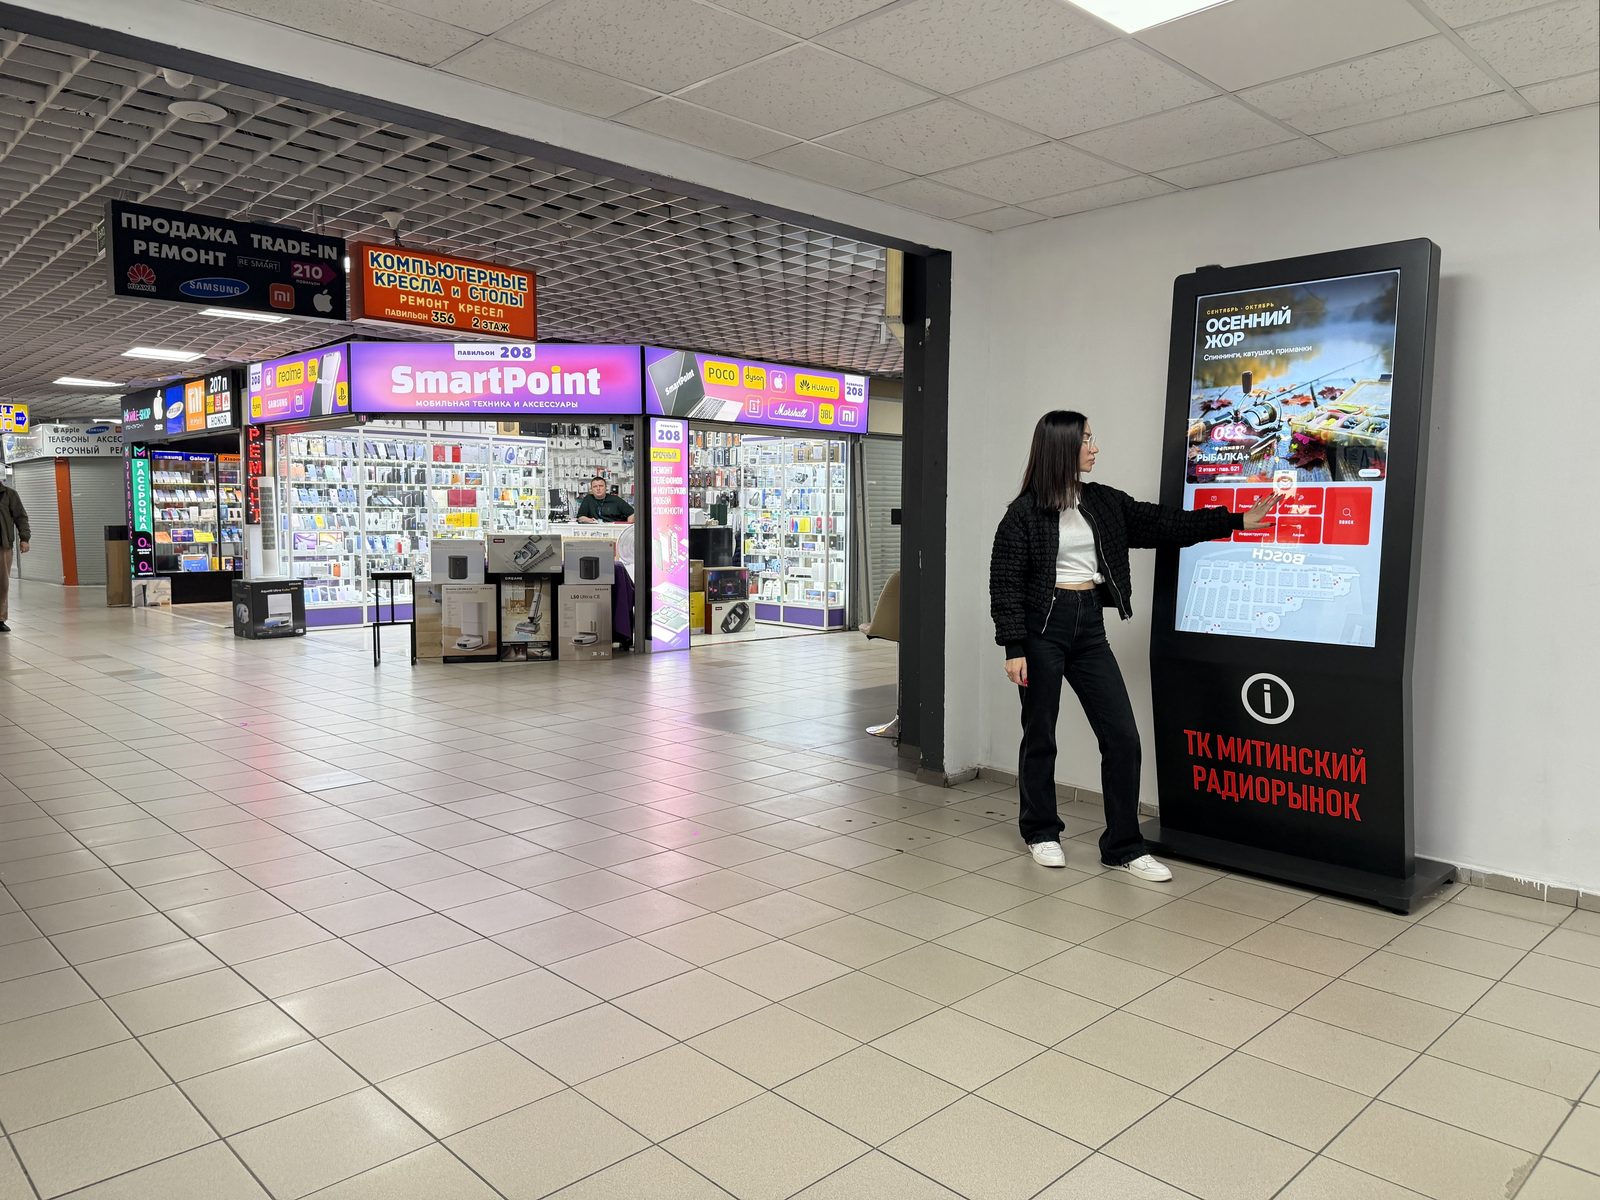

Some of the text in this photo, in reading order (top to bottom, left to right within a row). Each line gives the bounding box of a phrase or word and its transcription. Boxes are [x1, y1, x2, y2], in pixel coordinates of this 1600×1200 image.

[121, 212, 238, 245] ПРОДАЖА
[133, 239, 227, 267] РЕМОНТ
[250, 233, 338, 260] TRADE-IN
[293, 263, 323, 279] 210
[369, 250, 528, 292] КОМПЬЮТЕРНЫЕ
[189, 280, 240, 295] SAMSUNG
[374, 271, 444, 296] КРЕСЛА
[469, 286, 524, 308] СТОЛЫ
[400, 294, 503, 318] РЕМОНТ КРЕСЕЛ
[1206, 302, 1275, 315] СЕНТЯБРЬ ОКТЯБРЬ
[385, 308, 510, 332] ПАВИЛЬОН 356 2 ЭТАЖ
[1205, 305, 1292, 333] ОСЕННИЙ
[1204, 331, 1245, 350] ЖОР
[500, 346, 532, 359] 208
[1203, 345, 1312, 361] Спиннинги, катушки, приманки
[251, 375, 260, 386] 208
[278, 367, 301, 383] realme
[391, 365, 601, 395] SmartPoint
[708, 367, 735, 381] POCO
[745, 366, 765, 390] dyson
[209, 375, 222, 394] 207
[664, 369, 695, 396] SmartPoint
[811, 383, 836, 393] HUAWEI
[846, 386, 863, 396] 208
[415, 400, 470, 408] МОБИЛЬНАЯ
[473, 400, 511, 408] ТЕХНИКА
[522, 401, 578, 409] АКСЕССУАРЫ
[774, 403, 808, 418] Marshall
[820, 409, 833, 420] JBL
[60, 426, 80, 434] Apple
[658, 430, 681, 441] 208
[48, 435, 89, 443] ТЕЛЕФОНЫ
[55, 445, 100, 455] СРОЧНЫЙ
[1196, 452, 1250, 462] РЫБАЛКА+
[136, 461, 148, 530] РАССРОЧКА
[1183, 729, 1367, 785] ТК МИТИНСКИЙ
[1192, 764, 1362, 822] РАДИОРЫНОК
